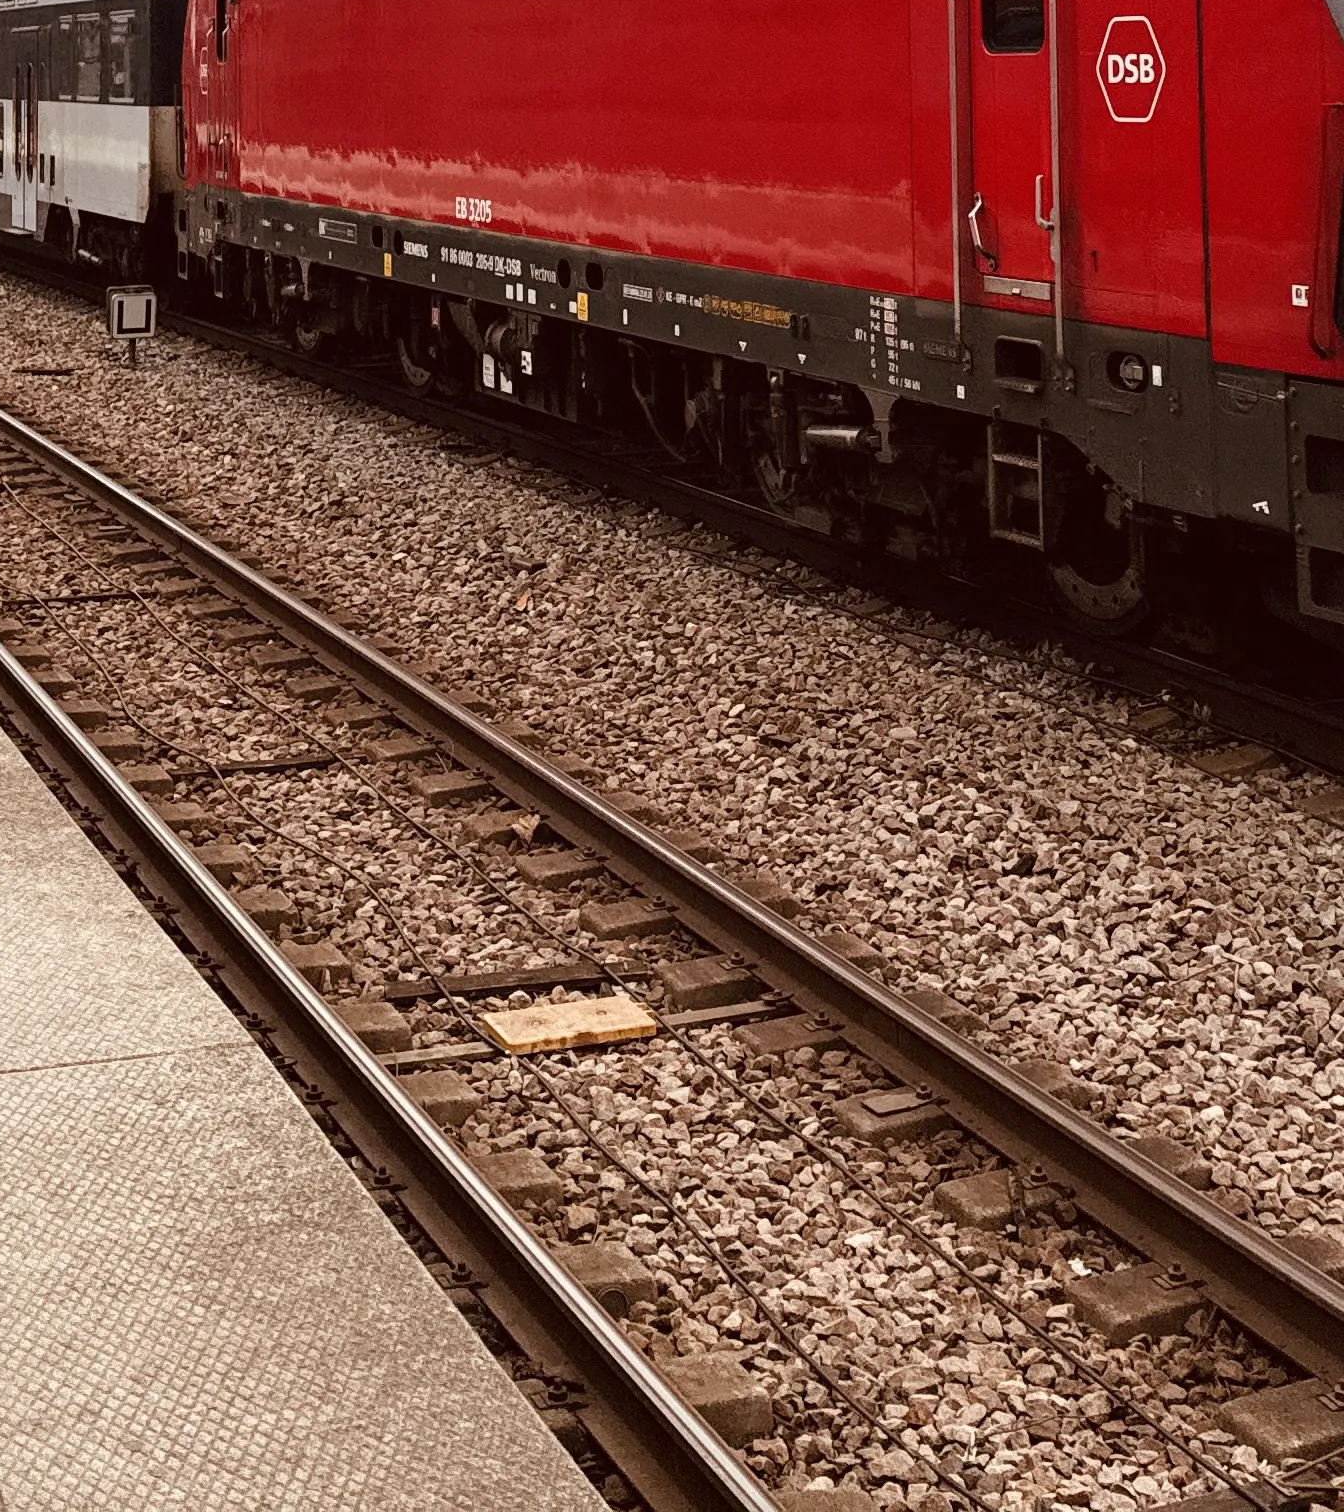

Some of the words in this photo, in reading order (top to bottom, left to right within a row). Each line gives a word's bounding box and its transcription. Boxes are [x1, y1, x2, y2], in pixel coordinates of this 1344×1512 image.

[1107, 53, 1155, 84] DSB
[455, 196, 468, 220] EB
[468, 198, 493, 224] 3205
[403, 240, 429, 259] SIEMENS
[529, 263, 556, 284] Vectron
